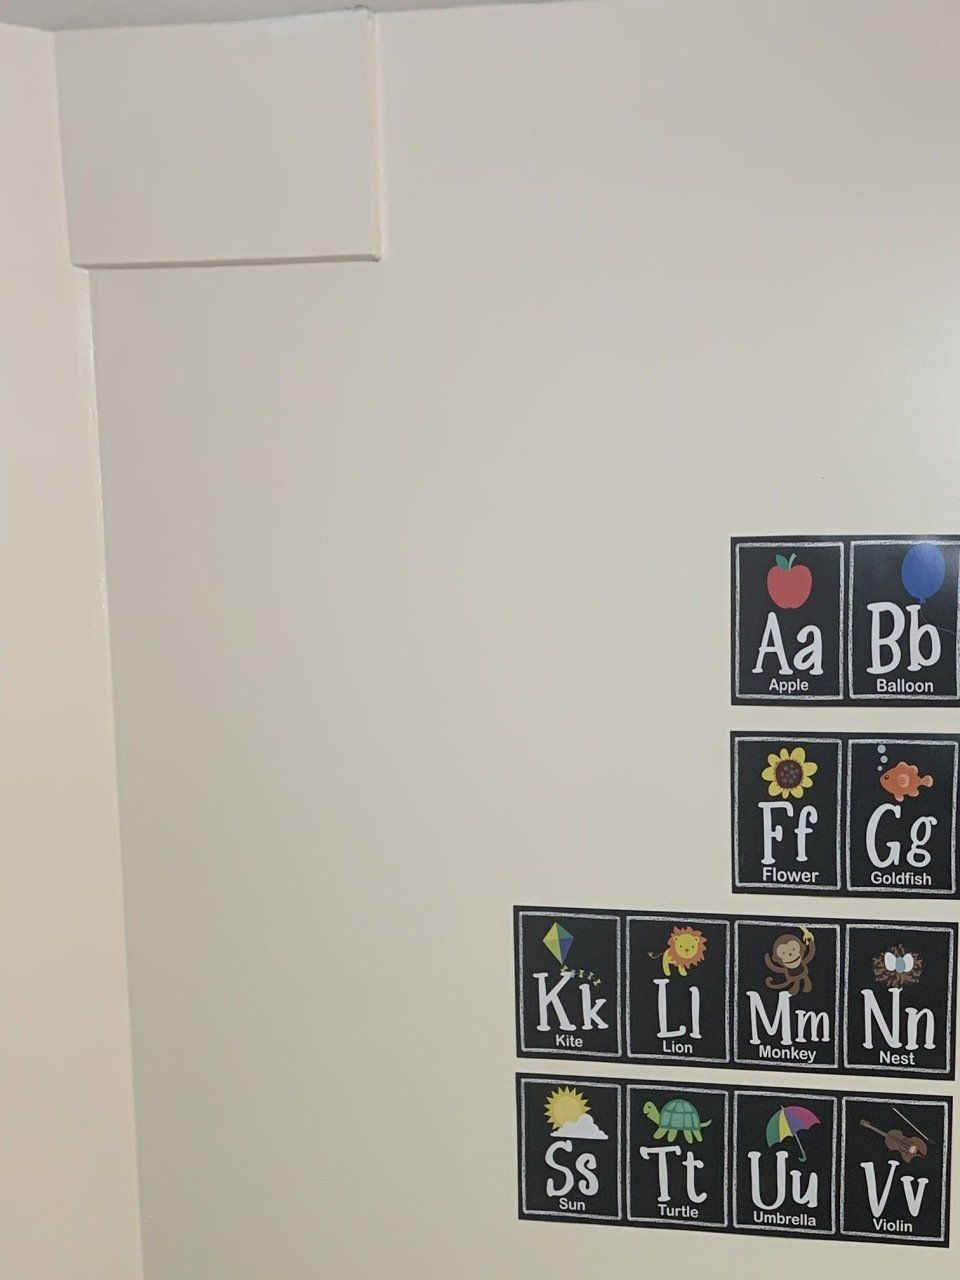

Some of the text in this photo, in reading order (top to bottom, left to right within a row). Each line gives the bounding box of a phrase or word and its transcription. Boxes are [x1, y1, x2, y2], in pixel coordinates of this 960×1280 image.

[752, 612, 824, 675] Aa
[867, 602, 942, 674] Bb
[768, 678, 809, 694] Apple
[876, 678, 934, 694] Balloon
[758, 802, 817, 865] Ff
[866, 804, 938, 868] Gg
[762, 867, 819, 883] Flower
[870, 871, 932, 886] Goldfish
[532, 972, 609, 1031] Kk
[654, 978, 702, 1039] Ll
[746, 990, 830, 1045] Mm
[861, 988, 936, 1050] Nn
[556, 1034, 583, 1048] Kite
[663, 1041, 692, 1053] Lion
[759, 1046, 816, 1064] Monkey
[879, 1052, 915, 1065] Nest
[545, 1141, 599, 1197] Ss
[640, 1145, 707, 1203] Tt
[748, 1150, 818, 1209] Uu
[559, 1199, 585, 1211] Sun
[861, 1160, 929, 1217] Vv
[658, 1204, 698, 1218] Turtle
[753, 1212, 816, 1226] Umbrella
[873, 1219, 913, 1232] Violin
